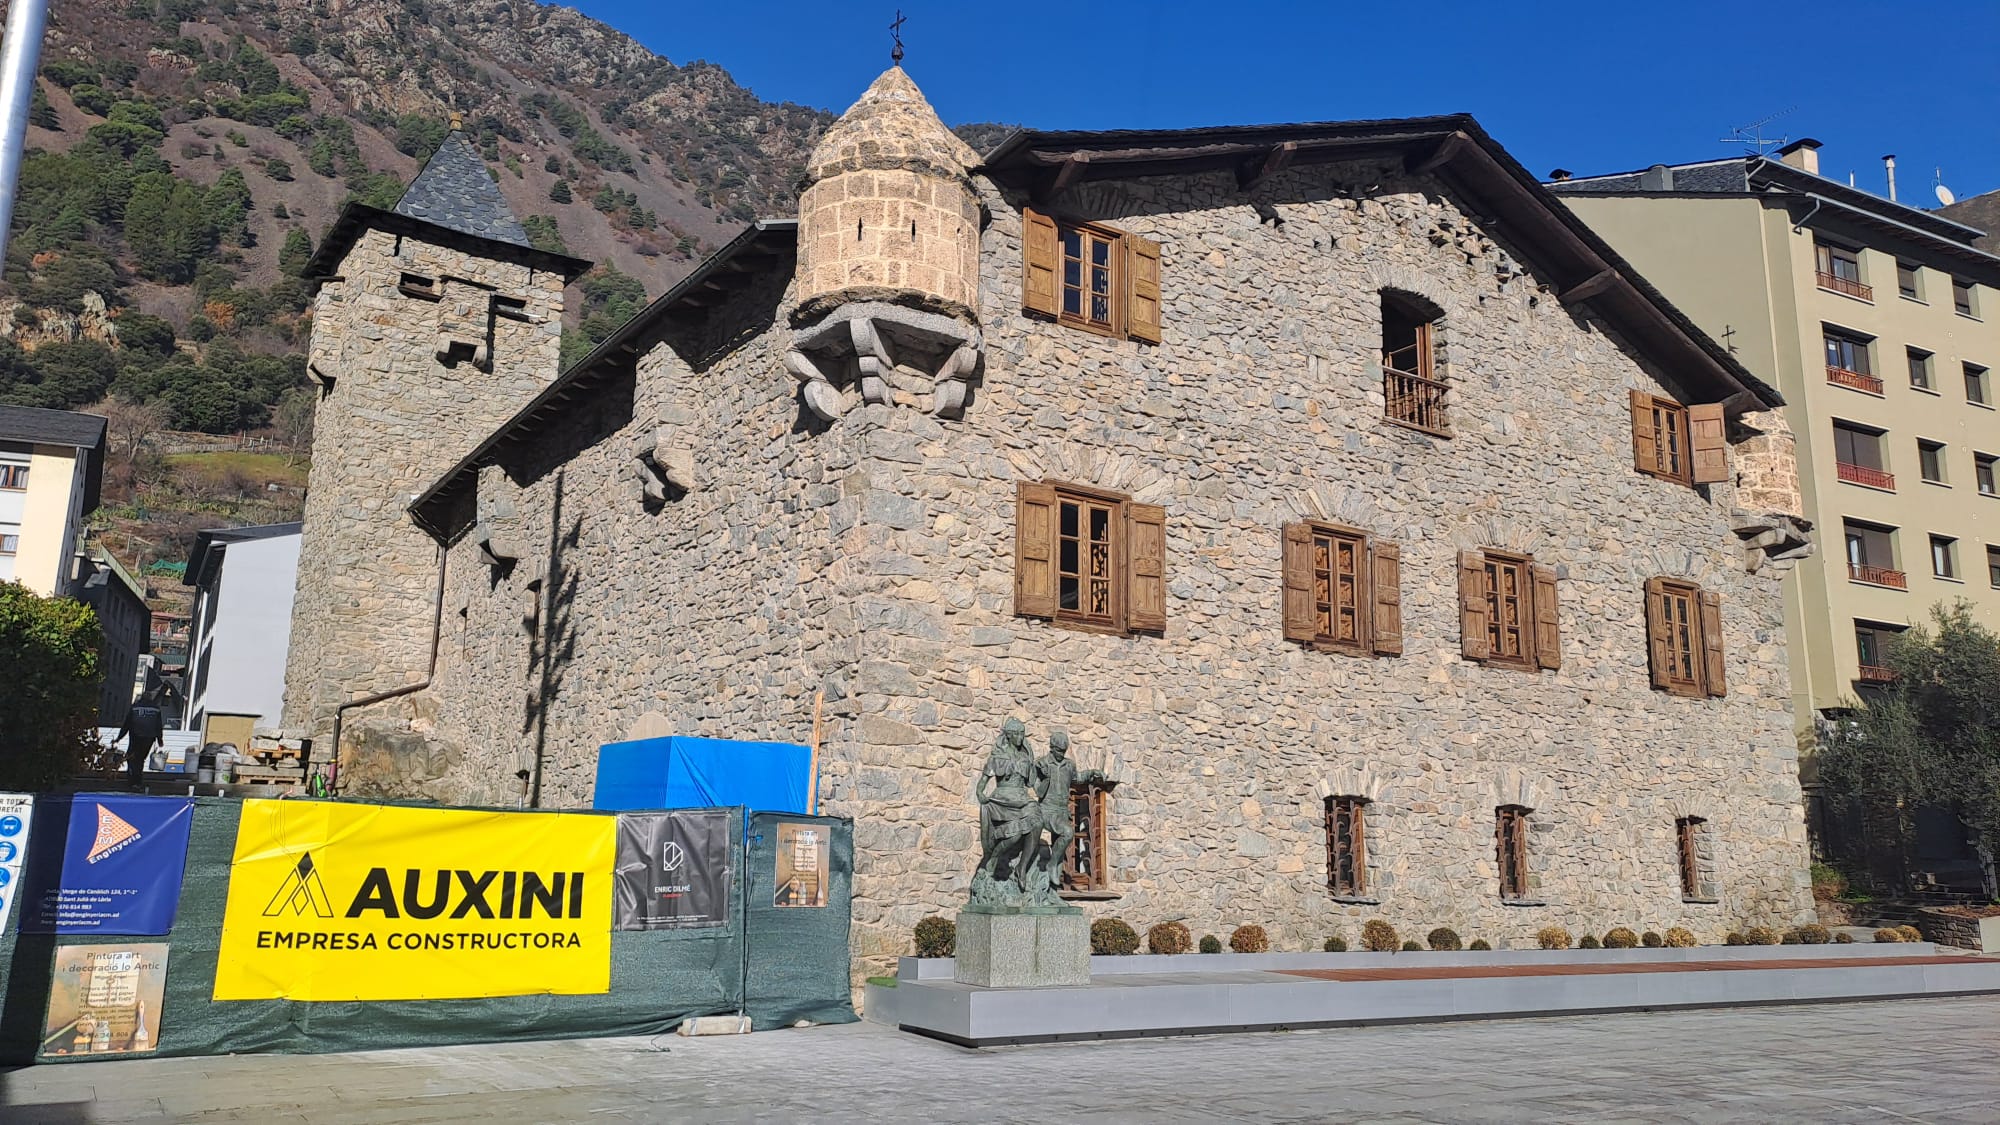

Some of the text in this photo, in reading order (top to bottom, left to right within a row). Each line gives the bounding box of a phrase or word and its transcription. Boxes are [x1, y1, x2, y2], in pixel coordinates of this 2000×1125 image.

[0, 806, 22, 814] RETAT
[89, 833, 142, 864] Enginyeria
[345, 867, 584, 919] AUXINI
[673, 884, 691, 893] DILMÉ
[256, 931, 581, 950] EMPRESA CONSTRUCTORA
[87, 952, 139, 960] Pintura art
[69, 964, 119, 973] decoració
[121, 963, 131, 971] lo
[134, 962, 160, 970] Antic
